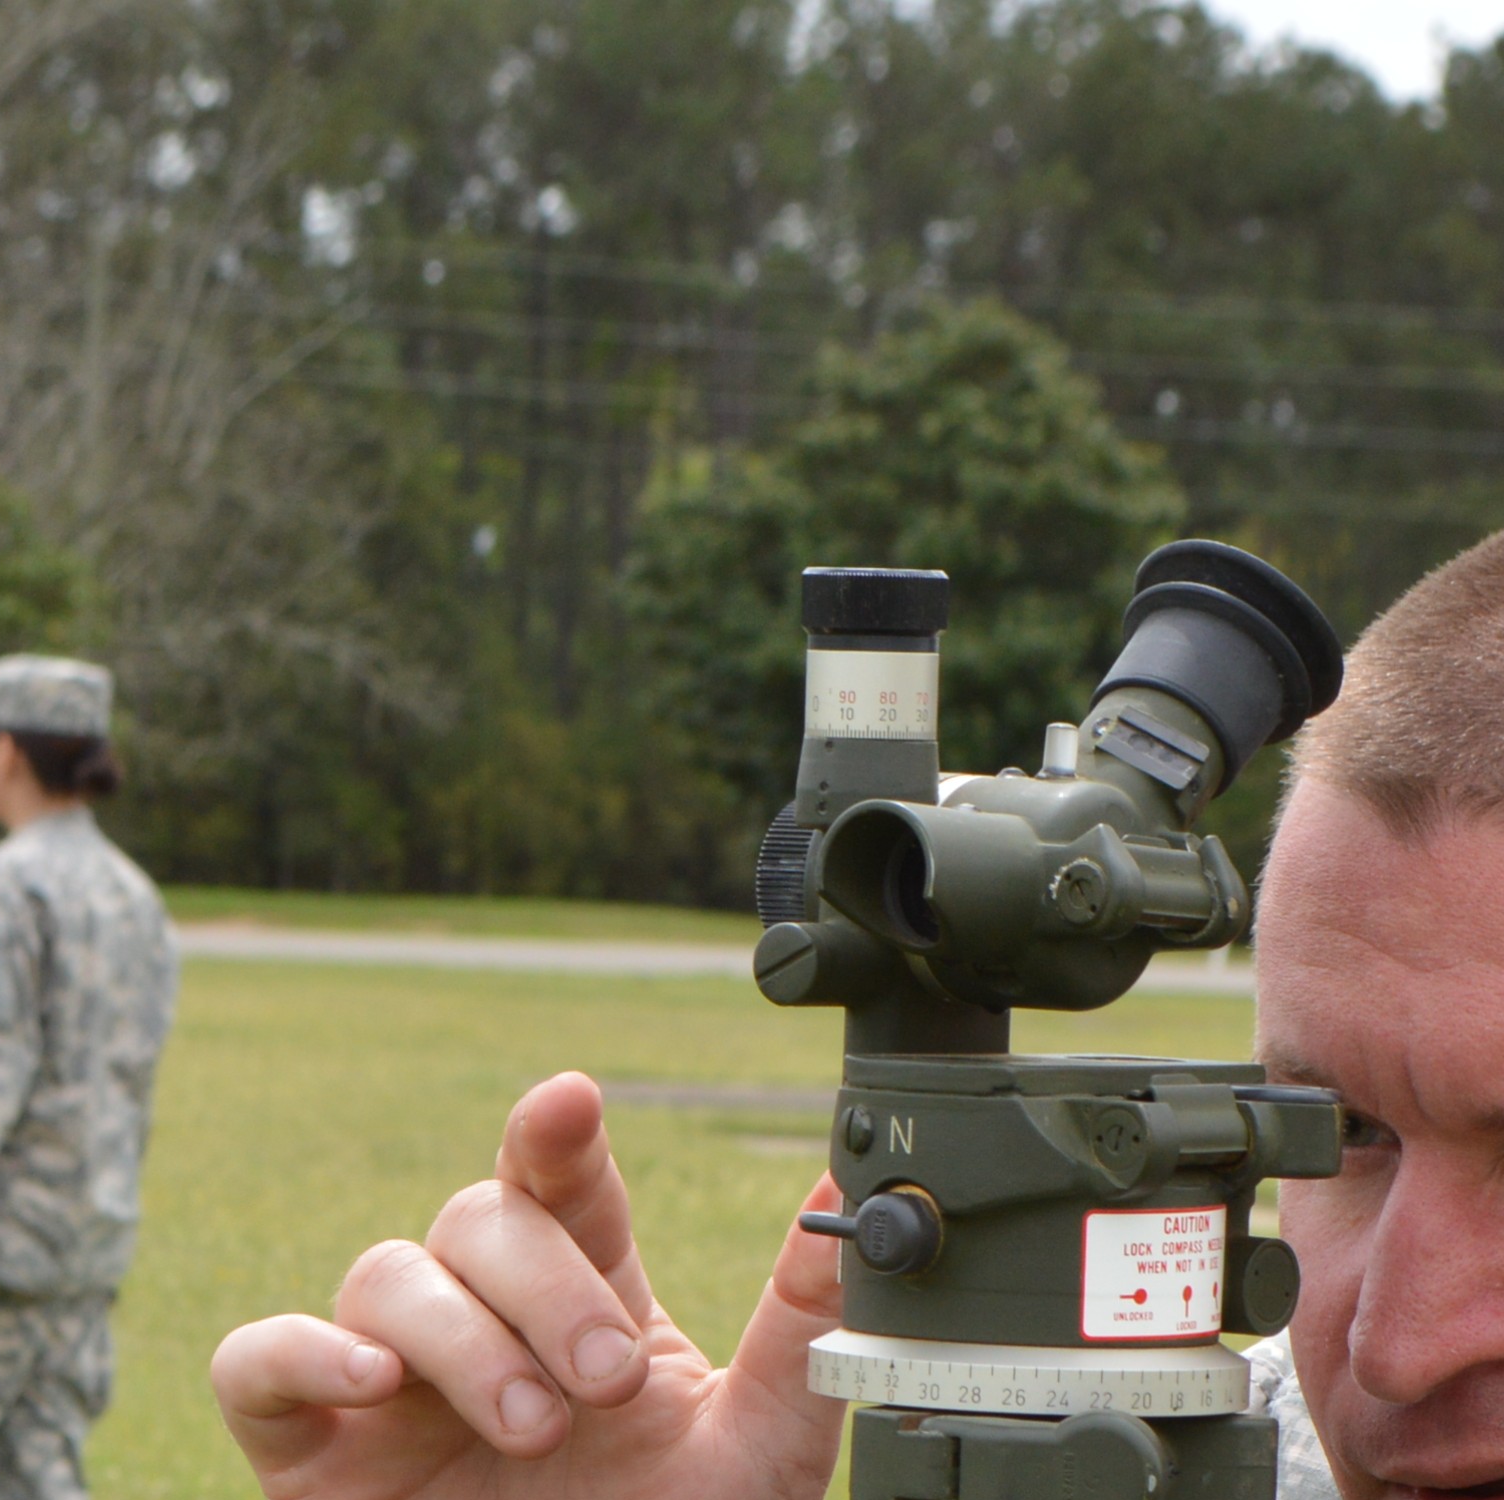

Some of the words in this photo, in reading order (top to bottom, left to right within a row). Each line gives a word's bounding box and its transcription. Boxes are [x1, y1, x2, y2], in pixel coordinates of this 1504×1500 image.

[839, 690, 856, 704] 90
[880, 691, 897, 705] 80
[840, 707, 855, 720] 10
[879, 708, 897, 721] 20
[890, 1115, 913, 1154] N
[1164, 1215, 1210, 1234] CAUTION
[1124, 1243, 1152, 1256] LOCK
[1162, 1240, 1203, 1256] COMPASS
[1137, 1261, 1167, 1274] WHEN
[1175, 1259, 1192, 1272] NOT
[1113, 1312, 1153, 1321] UNLOCKED
[885, 1373, 899, 1388] 32
[919, 1383, 941, 1401] 30
[959, 1386, 982, 1404] 28
[1002, 1388, 1027, 1406] 26
[1046, 1390, 1070, 1408] 24
[1090, 1391, 1113, 1409] 22
[1131, 1391, 1153, 1410] 20
[1170, 1391, 1184, 1409] 18
[1200, 1389, 1213, 1407] 16
